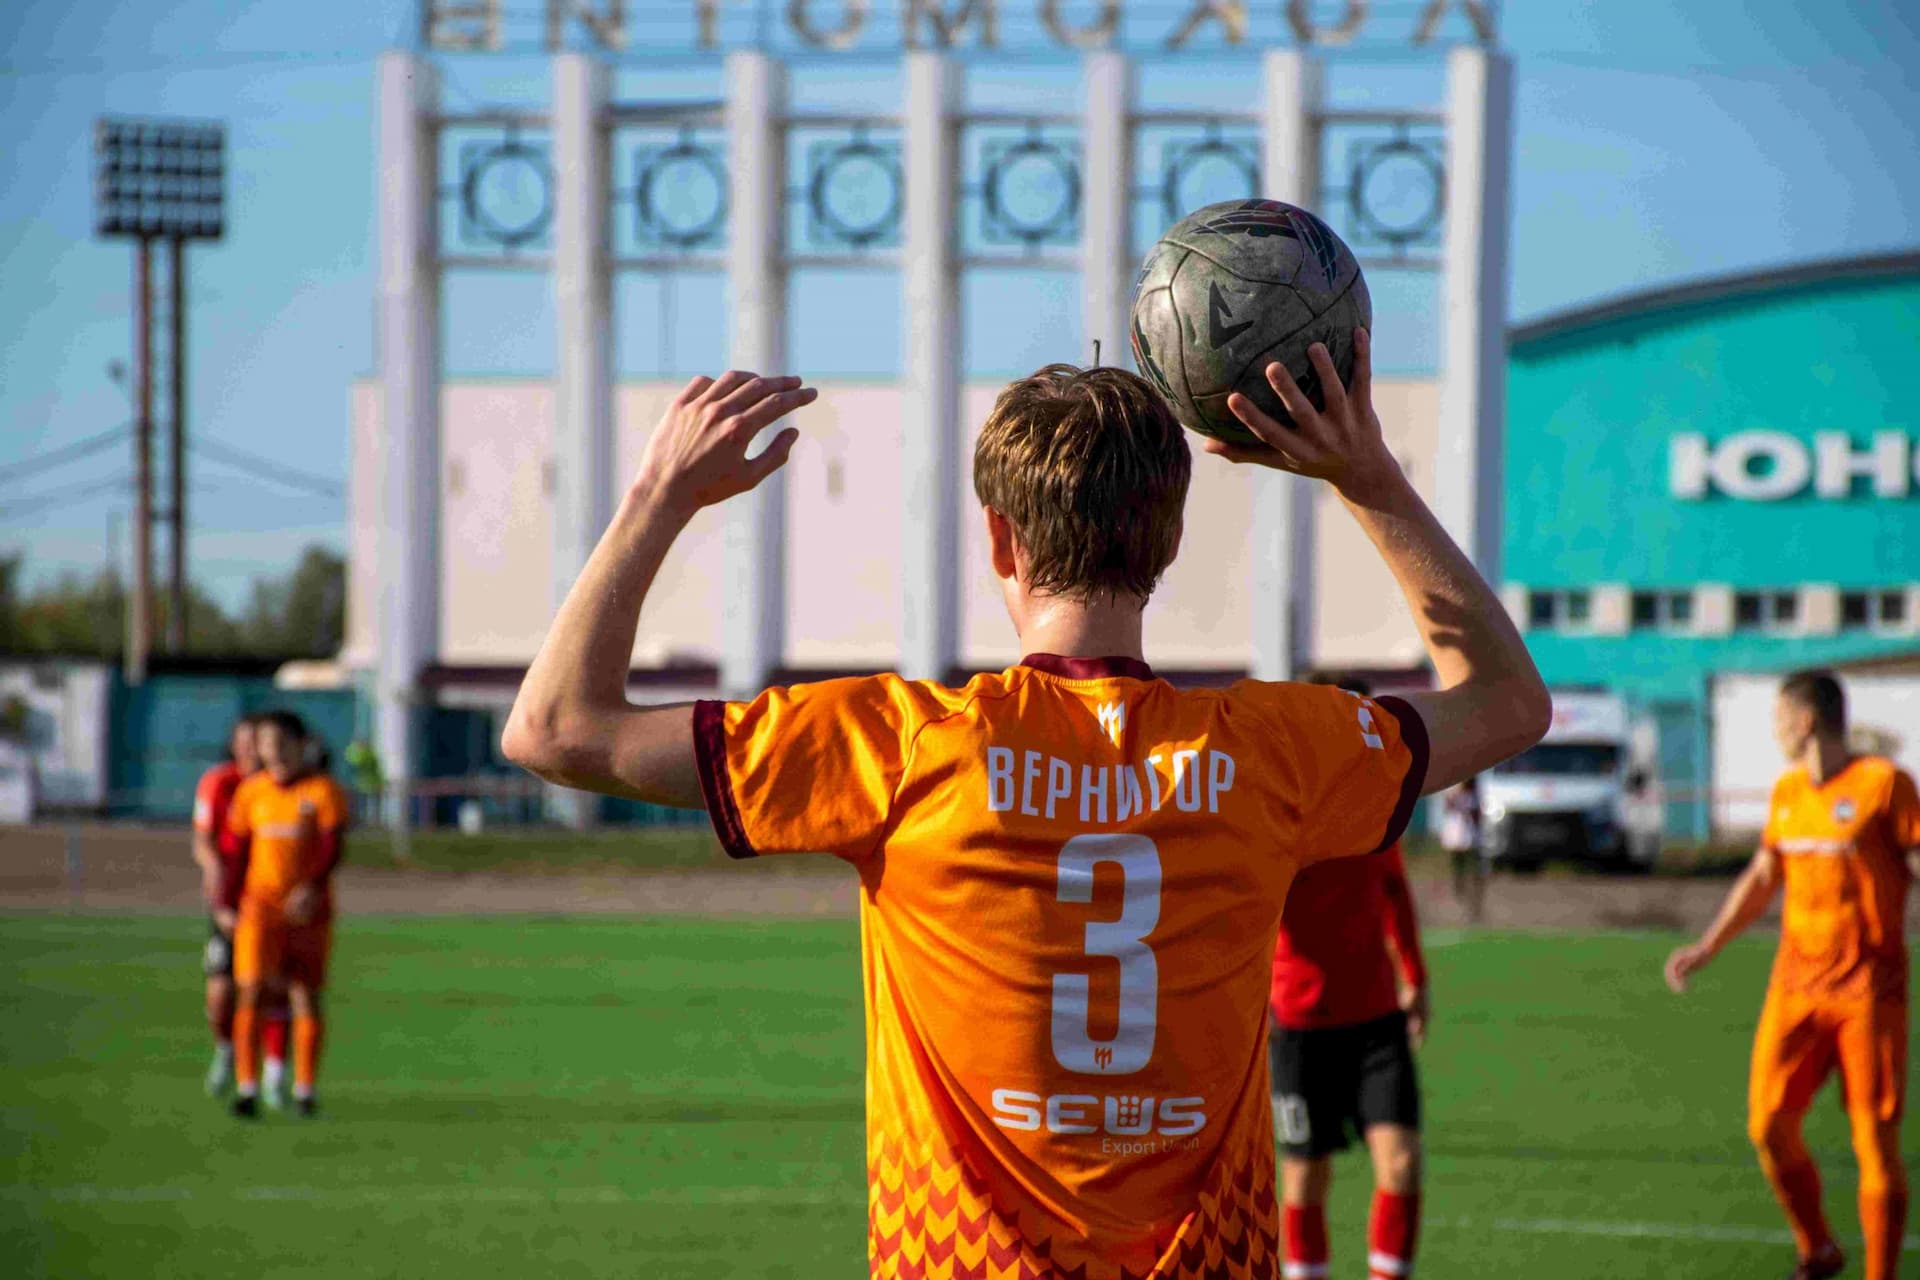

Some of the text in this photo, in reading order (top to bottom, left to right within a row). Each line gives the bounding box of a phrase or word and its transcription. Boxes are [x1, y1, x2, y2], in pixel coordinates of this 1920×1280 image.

[1671, 429, 1920, 501] ЮН
[987, 746, 1235, 823] ВЕРНИГОР
[1051, 833, 1162, 1075] 3
[991, 1088, 1207, 1135] SEUS
[1102, 1137, 1157, 1157] Export
